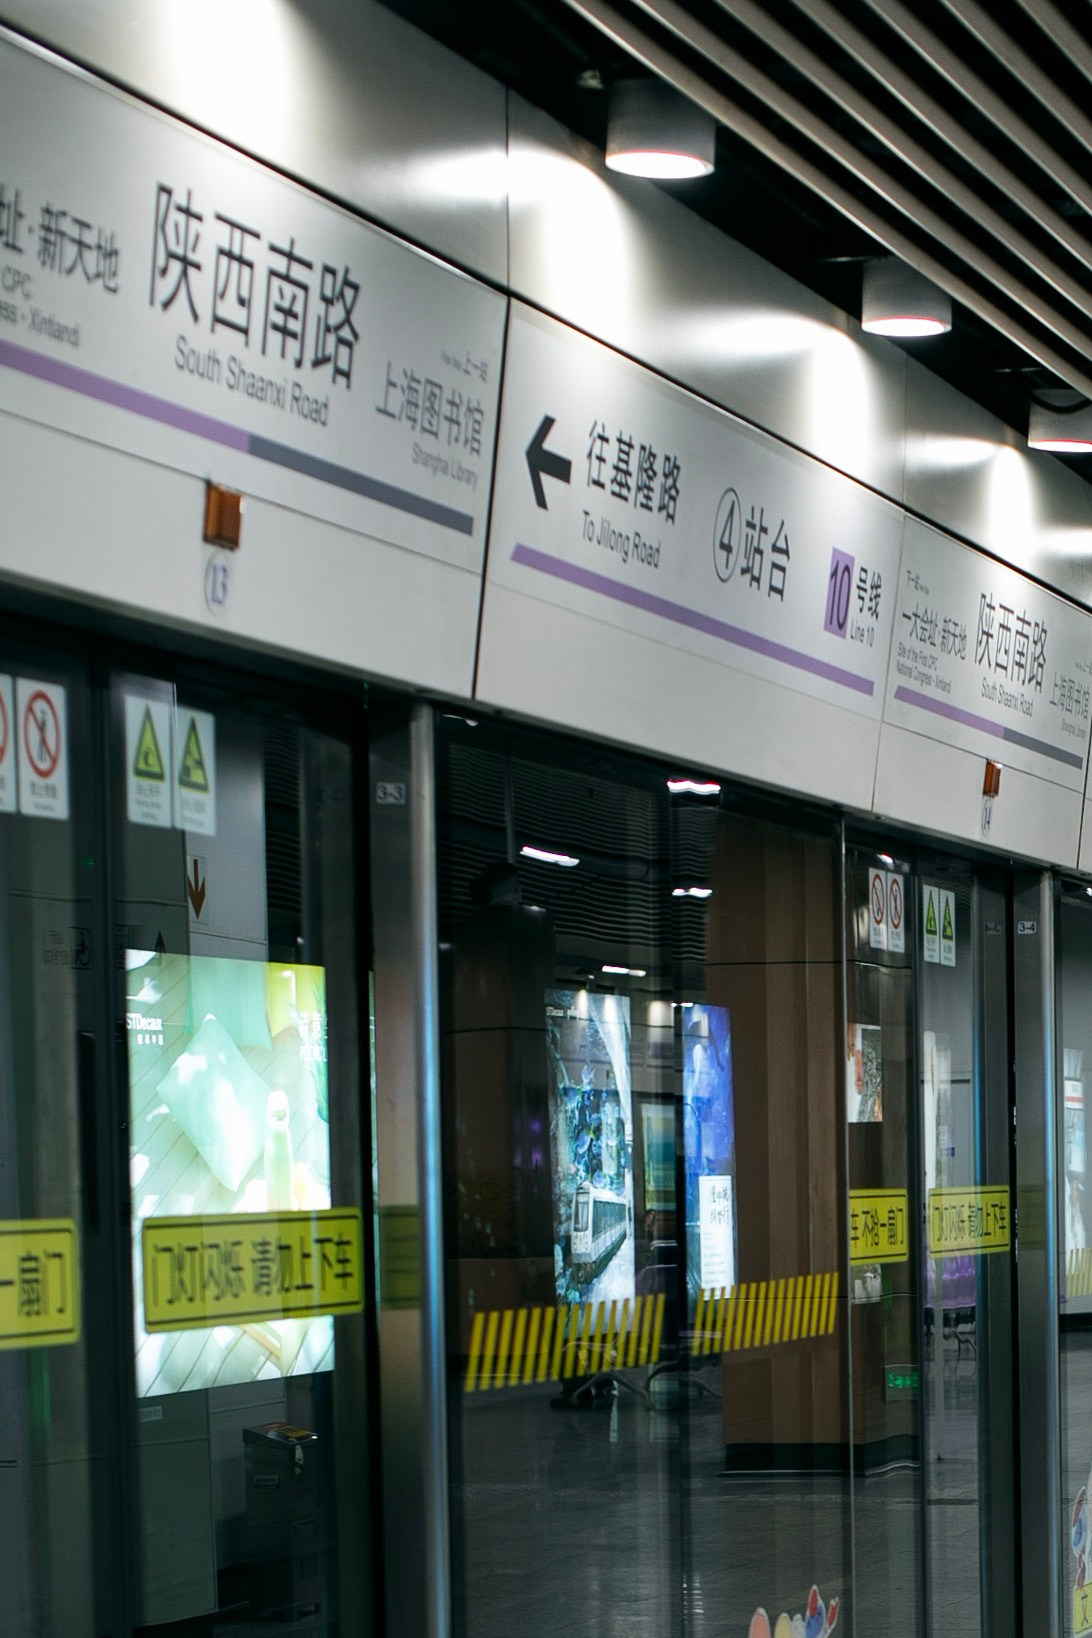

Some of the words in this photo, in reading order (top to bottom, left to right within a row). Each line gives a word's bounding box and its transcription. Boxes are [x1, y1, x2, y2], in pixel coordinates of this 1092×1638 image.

[2, 264, 32, 299] CPC
[149, 181, 362, 391] 陕西南路
[29, 305, 81, 347] Xintiandi
[174, 335, 221, 384] South
[226, 354, 287, 411] Shaanxi
[290, 380, 330, 427] Road
[375, 360, 485, 457] 上海图书馆
[586, 418, 681, 526] 往基隆路
[582, 508, 595, 543] To
[596, 516, 631, 564] Jilong
[631, 530, 661, 569] Road
[829, 559, 851, 631] 10
[856, 565, 882, 621] 号线
[850, 618, 865, 644] Line
[866, 625, 875, 648] 10
[974, 592, 1048, 694] 陕西南路
[981, 676, 998, 701] South
[997, 683, 1020, 712] Shaanxi
[1019, 692, 1035, 718] Road
[1018, 922, 1036, 933] 3-4
